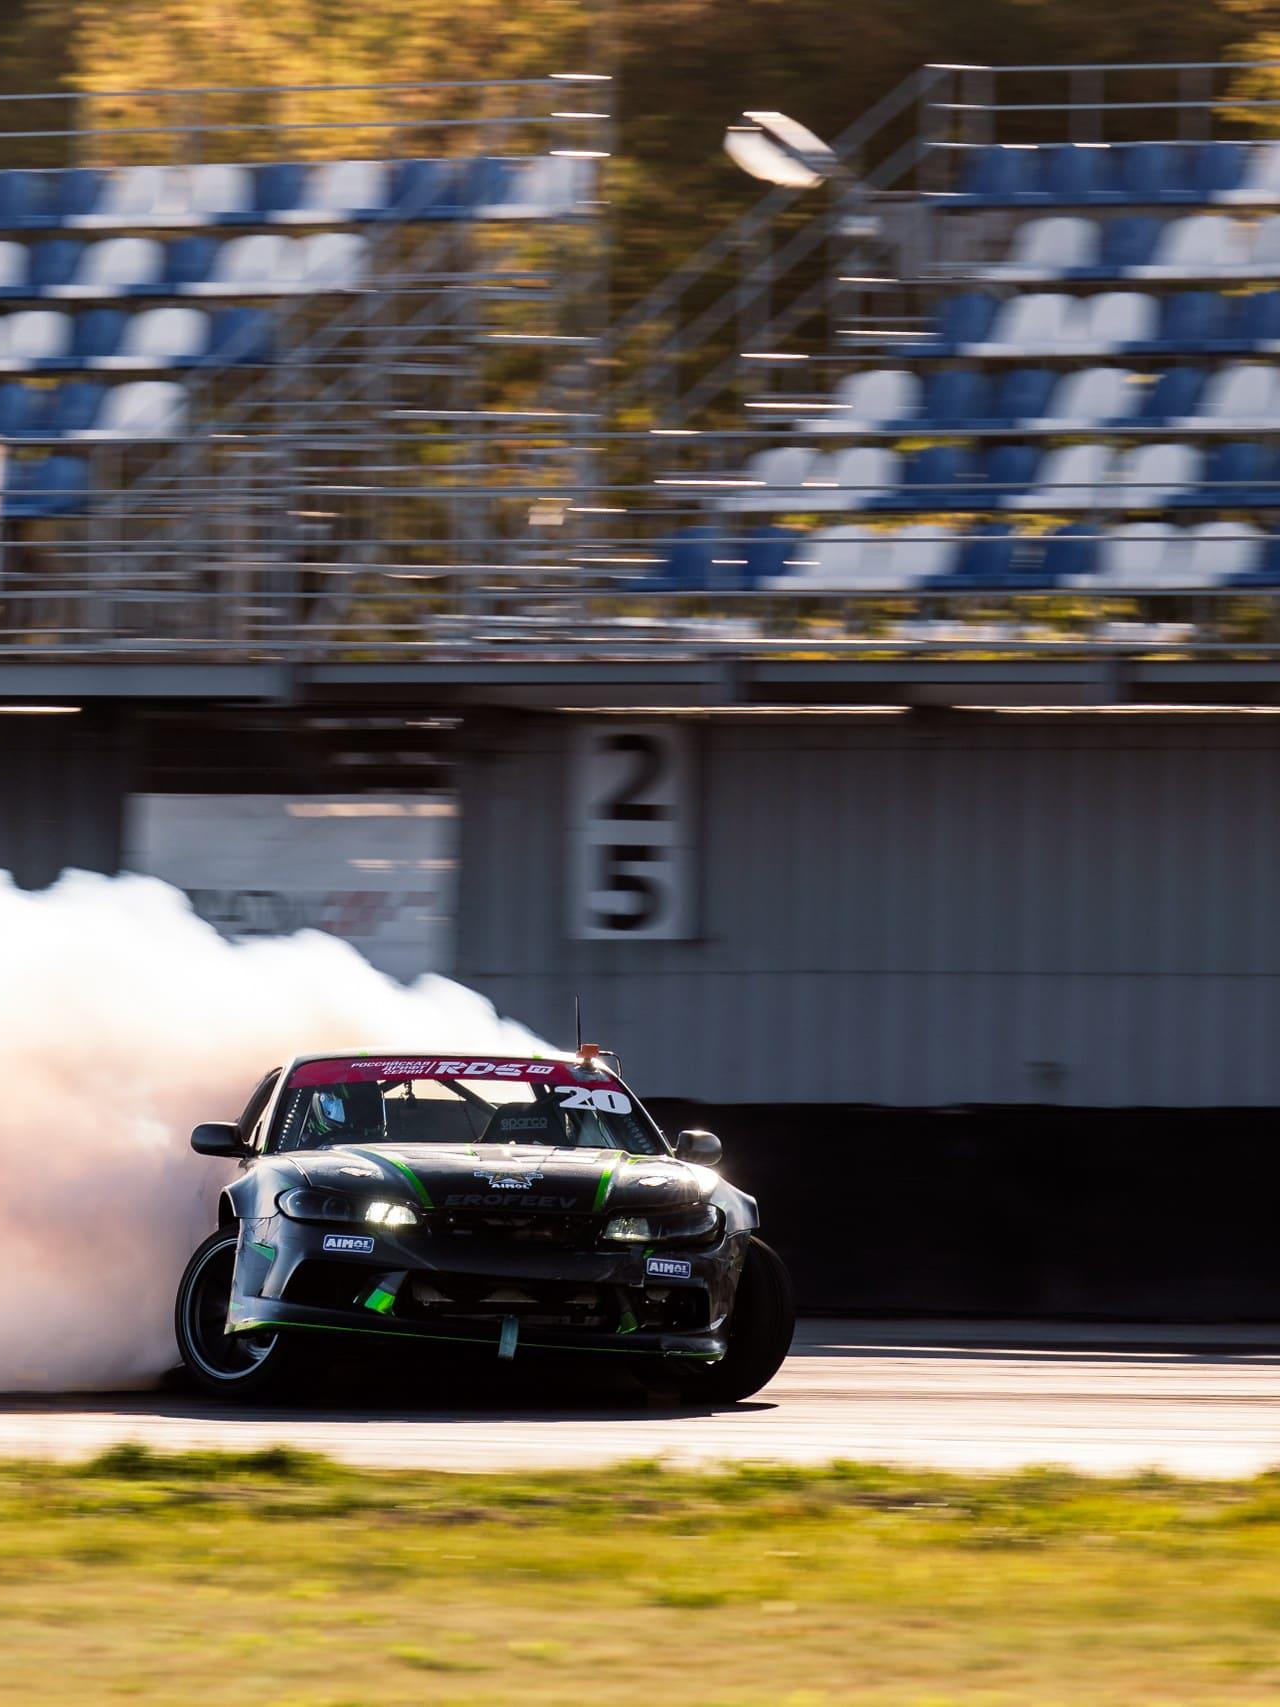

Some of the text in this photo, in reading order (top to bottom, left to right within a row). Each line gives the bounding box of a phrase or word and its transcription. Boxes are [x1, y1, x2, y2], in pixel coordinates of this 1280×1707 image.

[434, 1061, 527, 1077] RDS
[554, 1085, 632, 1115] 20
[444, 1193, 577, 1209] EROFEEV
[325, 1238, 371, 1250] AIMOL
[649, 1261, 689, 1275] AIMOL
